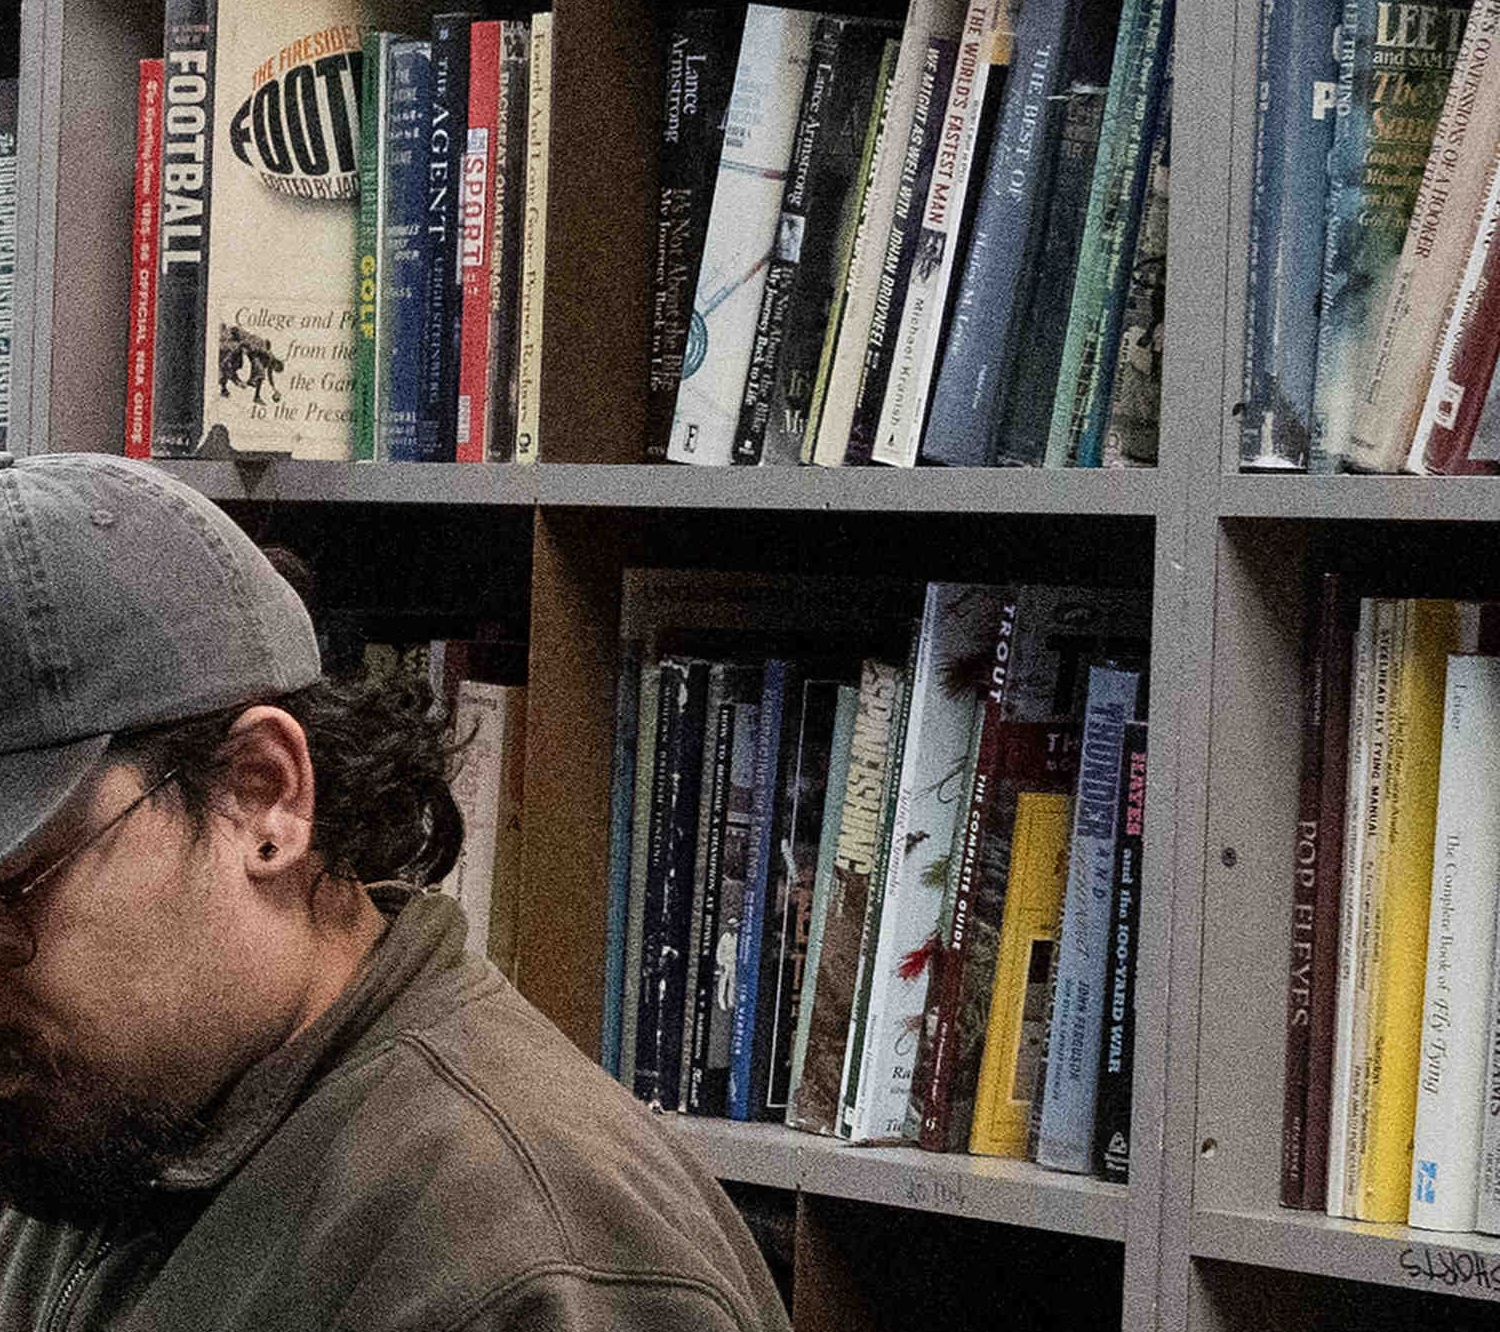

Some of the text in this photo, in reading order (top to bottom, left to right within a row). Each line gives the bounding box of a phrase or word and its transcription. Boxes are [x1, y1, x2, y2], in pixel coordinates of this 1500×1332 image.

[1376, 2, 1439, 50] LEE
[663, 32, 689, 143] Armstrong
[683, 54, 707, 115] Lance
[1337, 39, 1356, 117] TREVINO
[928, 6, 987, 225] THE WORLD'S FASTEST MAN
[162, 49, 207, 275] FOOTBALL
[428, 102, 451, 242] AGENT
[464, 157, 485, 264] SPORT
[895, 184, 913, 220] WIN
[1415, 189, 1449, 258] HOOKER
[235, 305, 334, 332] College and
[360, 254, 378, 340] GOLF
[903, 297, 925, 362] Michael
[131, 269, 148, 444] OFFICIAL NBA GUIDE
[286, 337, 327, 362] from
[289, 372, 316, 391] the
[273, 402, 299, 421] the
[989, 605, 1016, 705] TROUT
[1376, 628, 1391, 705] STEELHEAD
[1373, 709, 1386, 734] FLY
[1078, 701, 1125, 839] THUNDER
[1370, 741, 1384, 780] TYING
[1367, 785, 1381, 838] MANUAL
[951, 773, 987, 951] THE COMPLETE GUIDE
[1298, 820, 1318, 888] POP
[1107, 751, 1147, 1074] HAYES and the 100-YARD WAR
[1441, 863, 1459, 930] Complete
[1439, 935, 1454, 974] Book
[1431, 999, 1449, 1033] Fly
[1423, 1039, 1448, 1095] Tying
